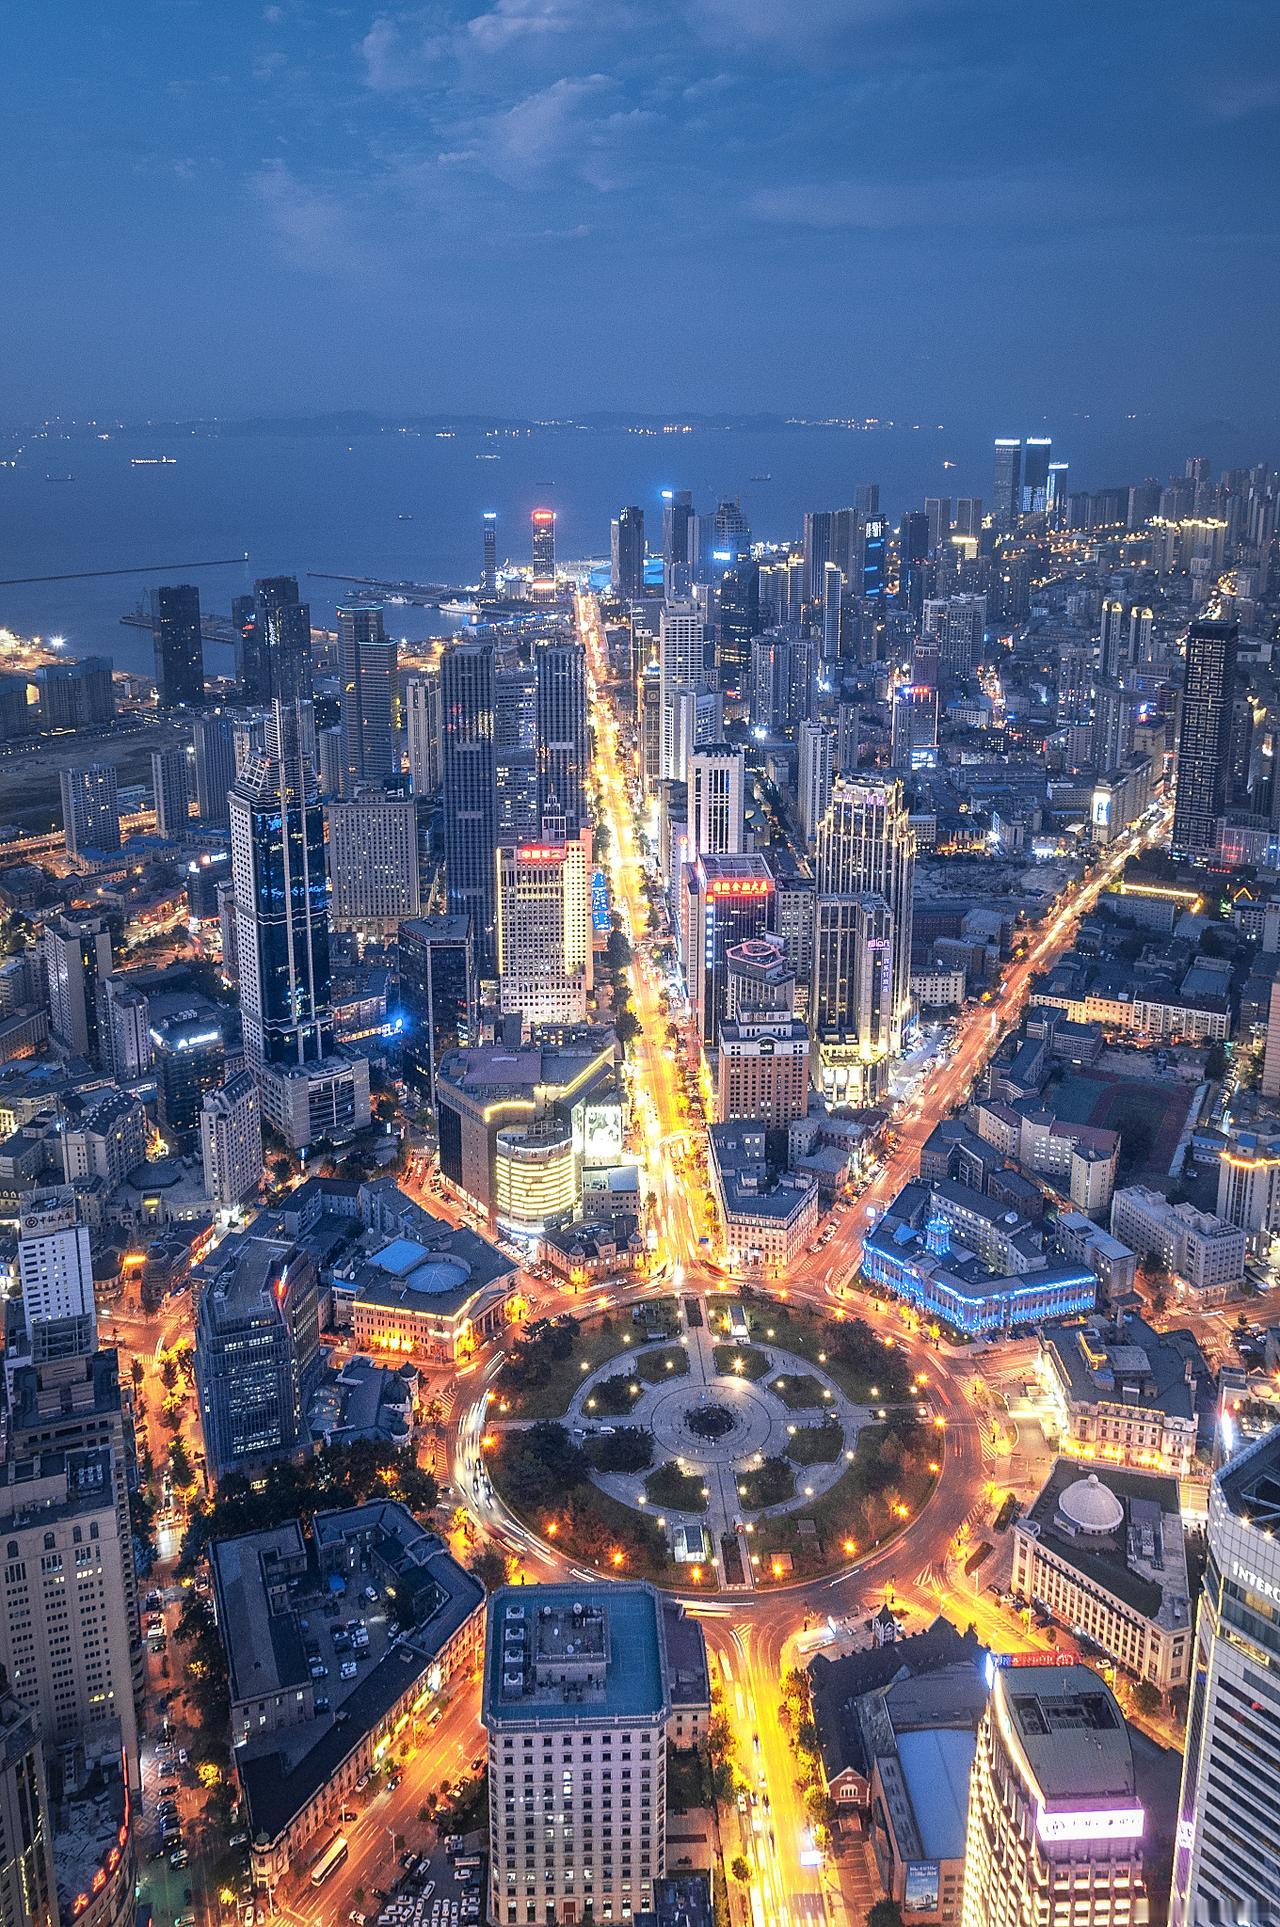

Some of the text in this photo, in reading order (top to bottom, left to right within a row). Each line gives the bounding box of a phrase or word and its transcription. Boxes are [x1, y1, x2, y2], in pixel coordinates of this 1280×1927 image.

[713, 880, 768, 892] 国际金融大厦
